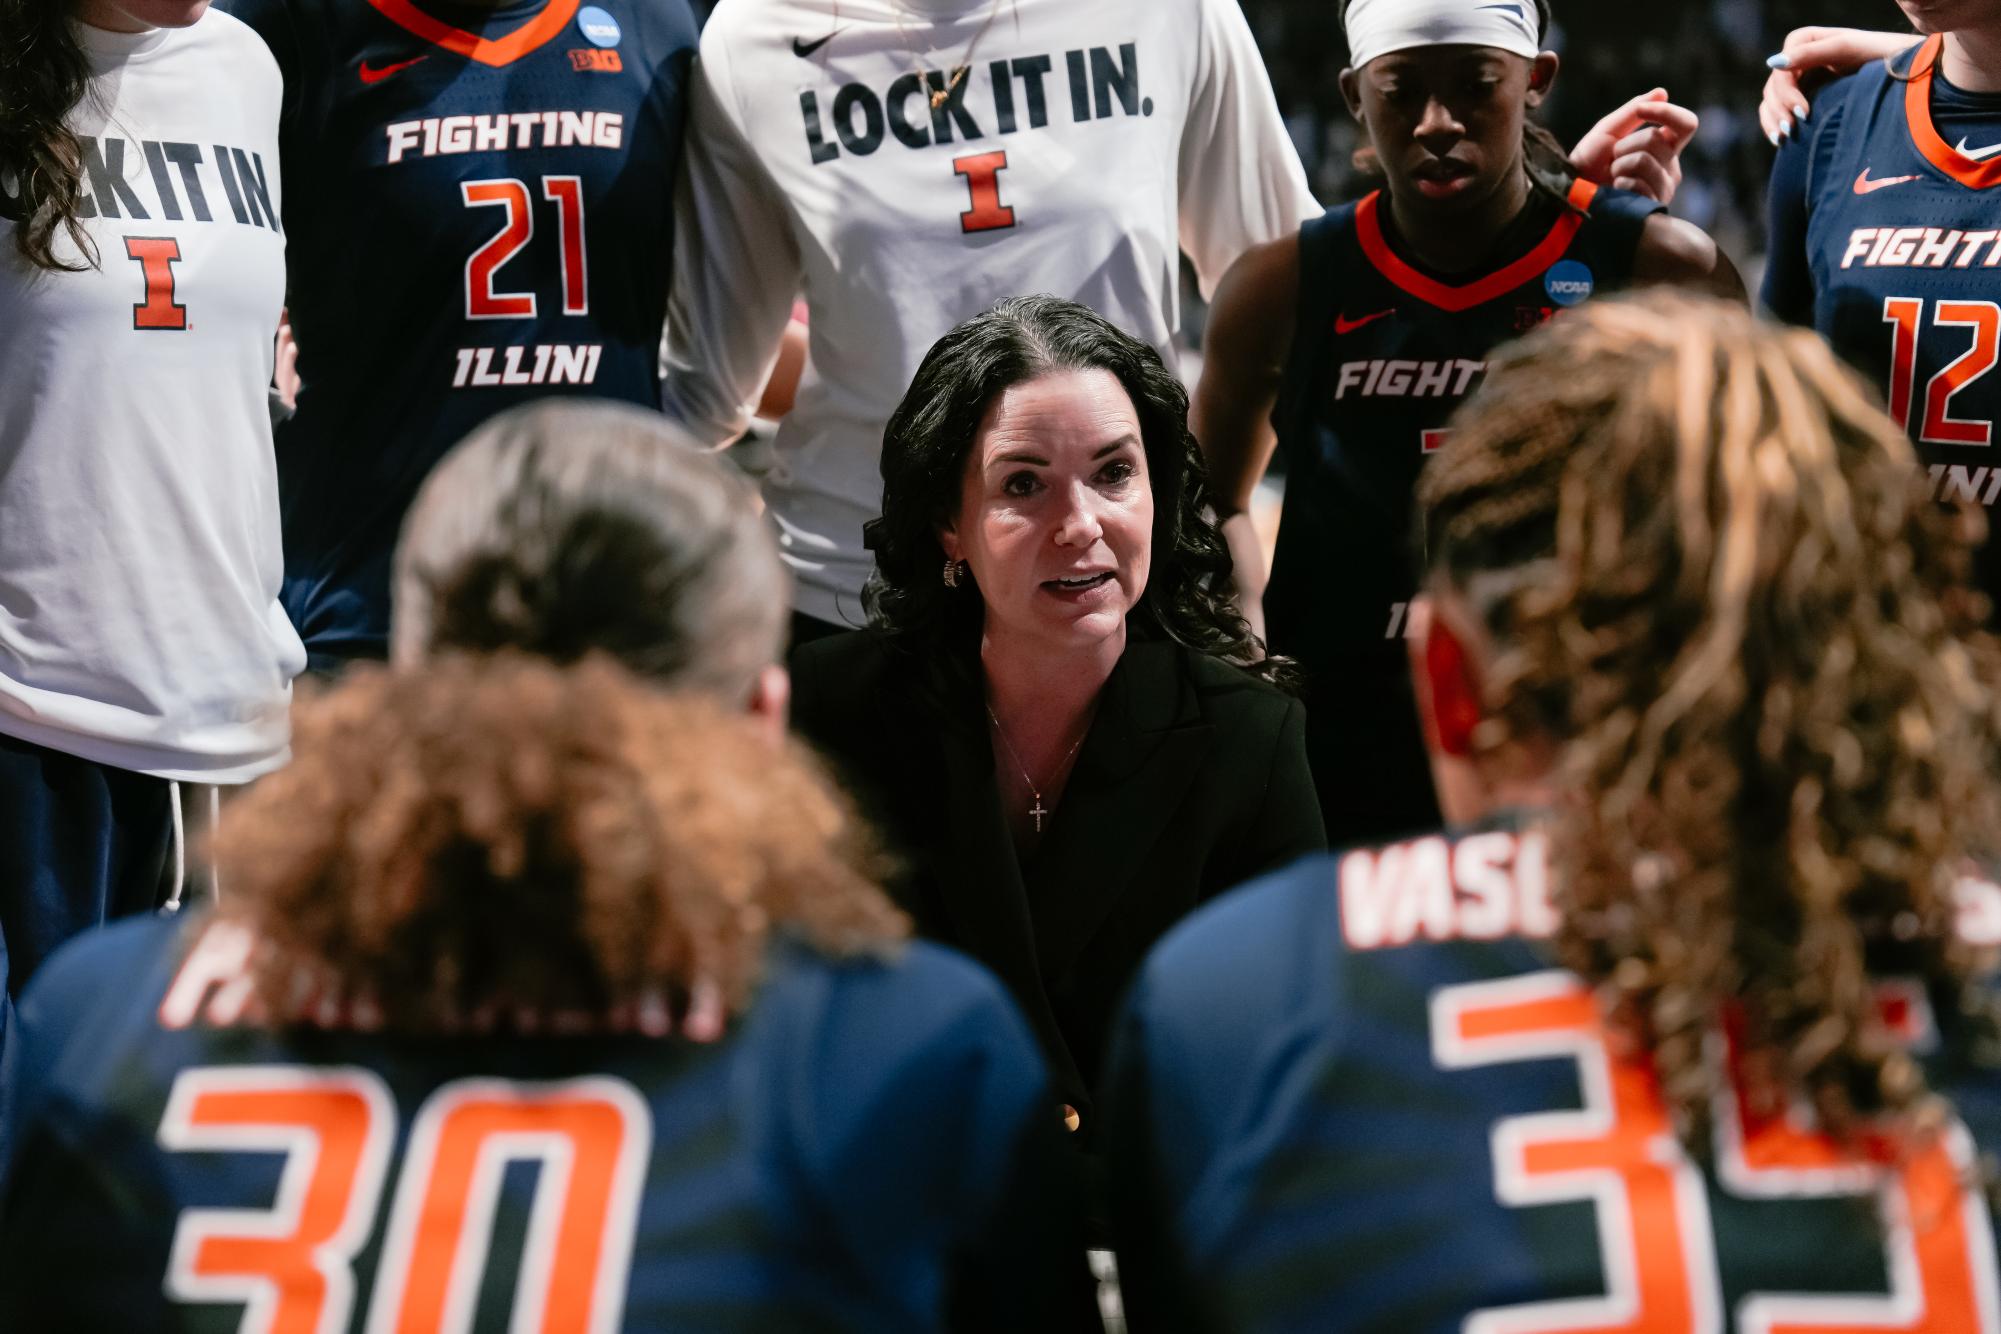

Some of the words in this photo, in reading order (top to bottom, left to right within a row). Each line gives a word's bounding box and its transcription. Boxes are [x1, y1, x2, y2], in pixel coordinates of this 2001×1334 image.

[386, 111, 623, 164] FIGHTING
[799, 64, 984, 165] LOCK
[989, 53, 1052, 134] IT
[1065, 42, 1154, 123] IN.
[141, 140, 213, 222] IT
[459, 175, 589, 320] 21
[1550, 281, 1590, 293] NCAA
[452, 345, 602, 387] ILLINI
[1882, 296, 2001, 447] 12
[158, 1063, 653, 1334] 30
